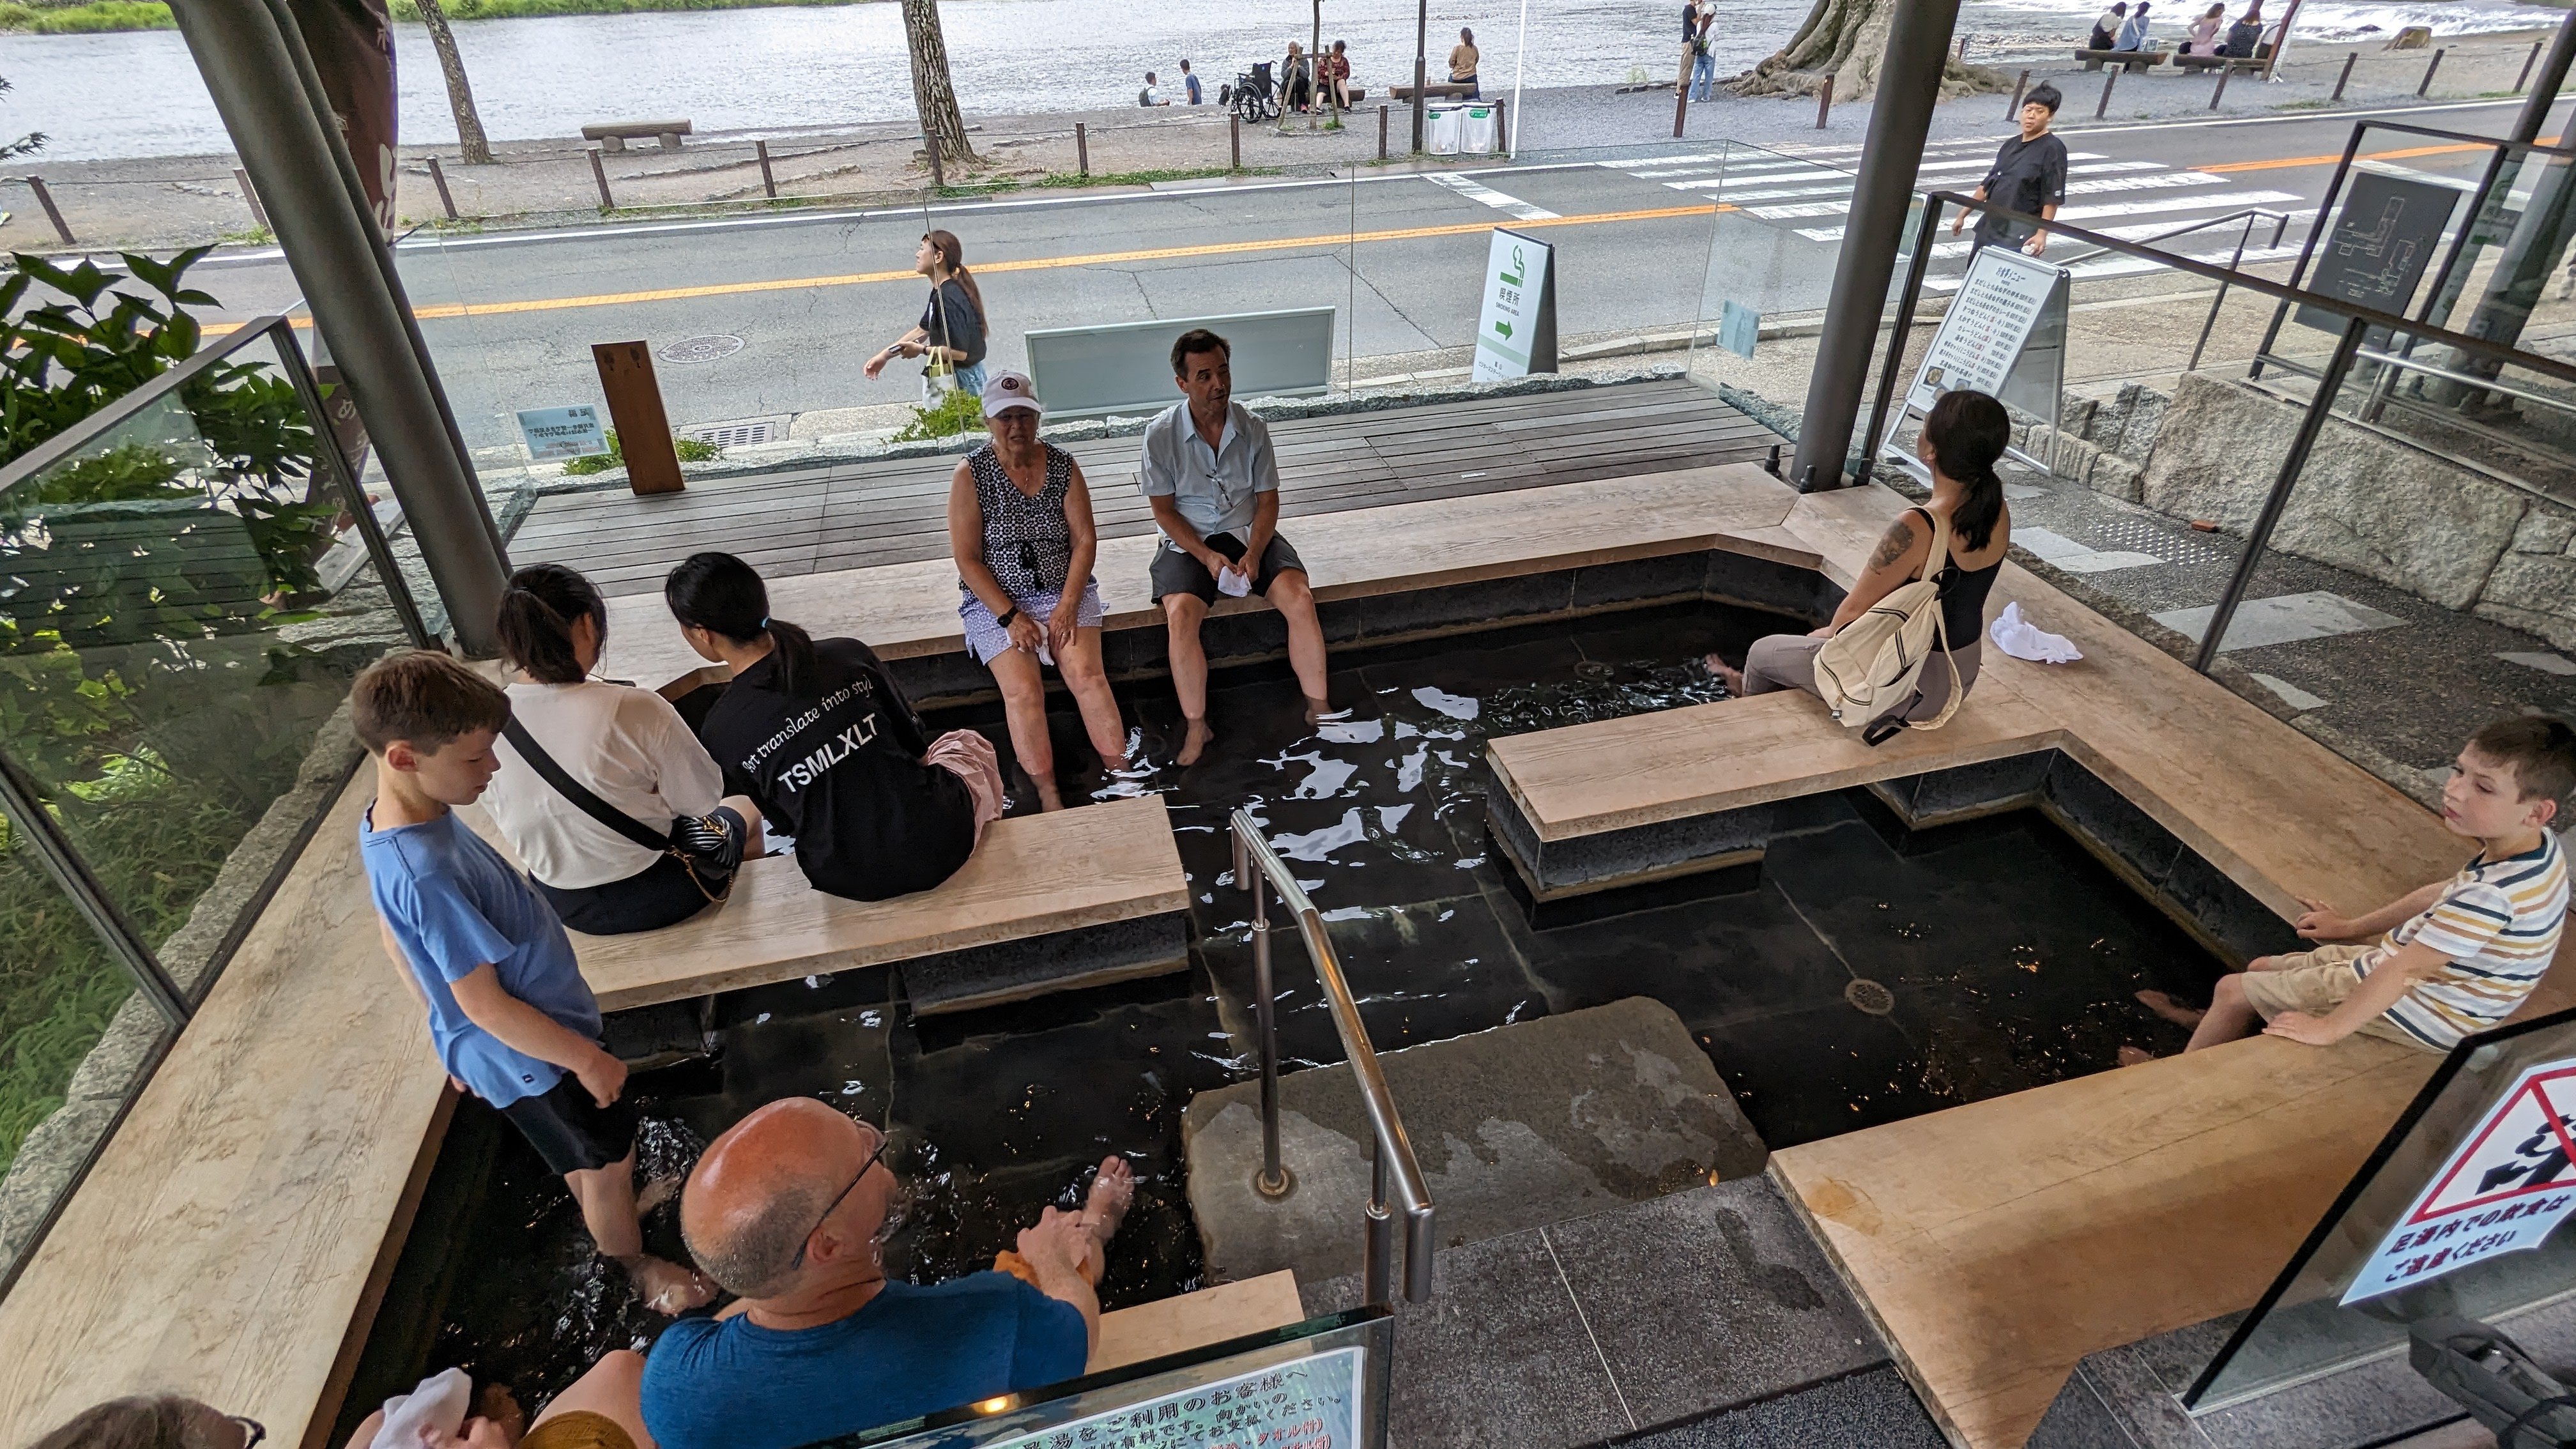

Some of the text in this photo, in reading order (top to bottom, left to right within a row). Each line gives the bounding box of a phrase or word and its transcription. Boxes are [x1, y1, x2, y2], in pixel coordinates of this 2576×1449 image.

[1496, 302, 1519, 317] SMOKING AREA
[1499, 288, 1521, 307] 喫煙所
[756, 707, 820, 758] translate
[822, 688, 850, 712] into
[777, 712, 878, 793] TSMLXLT
[2384, 1193, 2572, 1256] 足湯内での飲食は
[2384, 1230, 2518, 1283] ご遠慮ください
